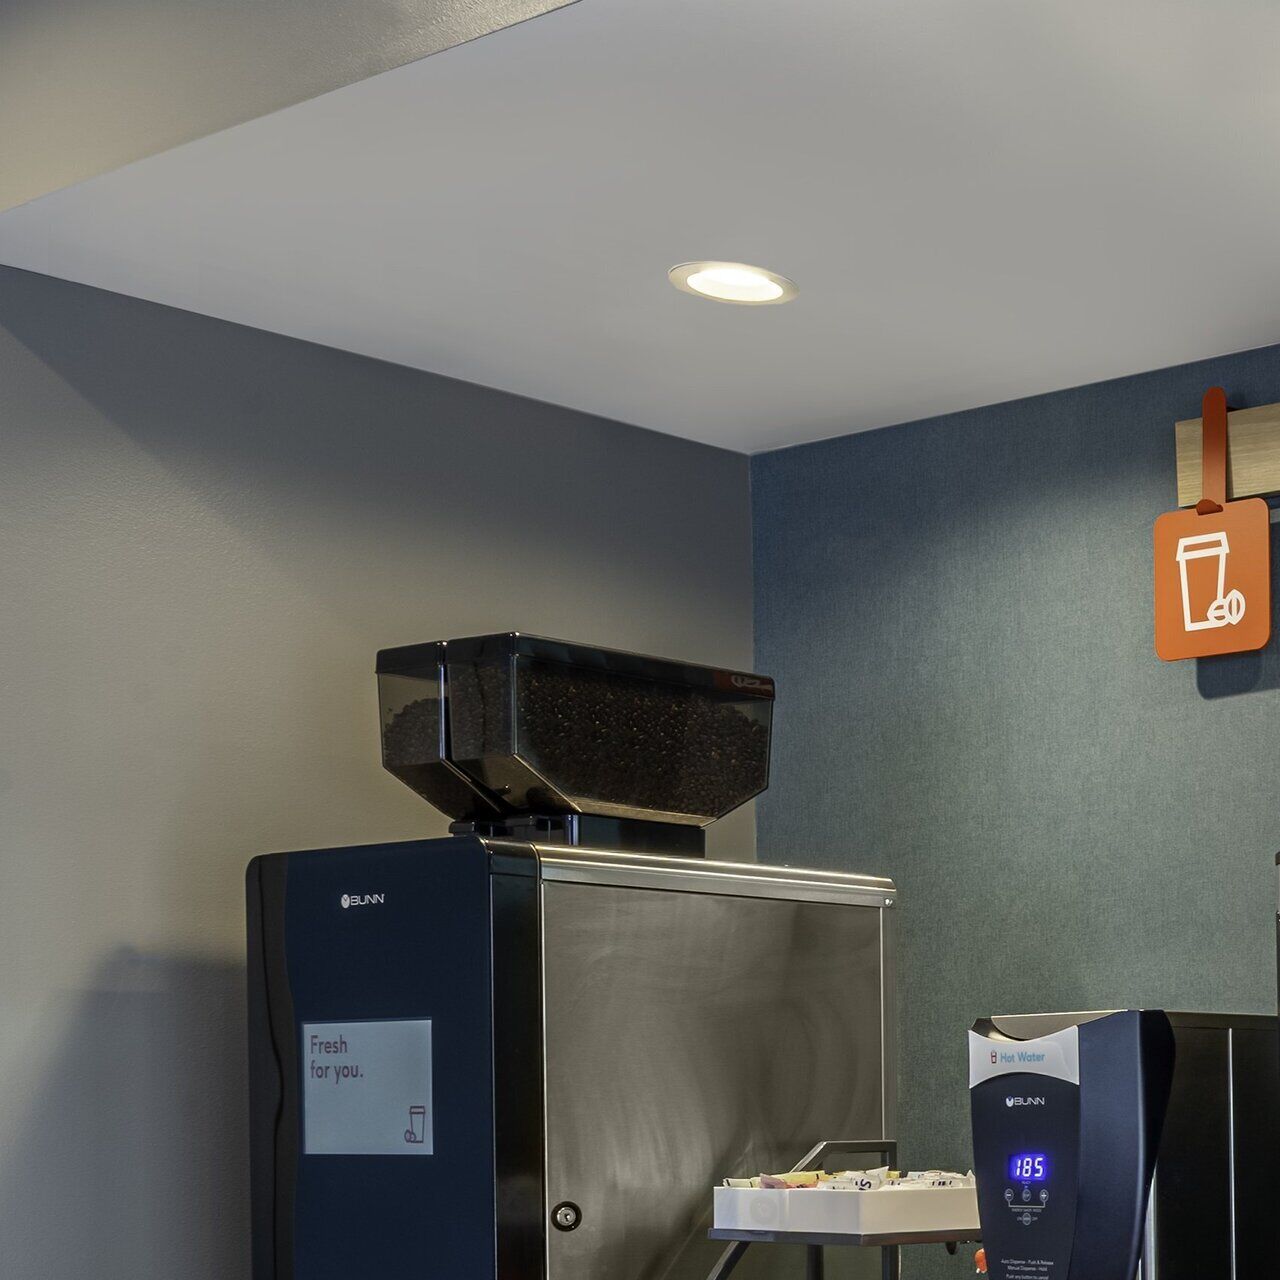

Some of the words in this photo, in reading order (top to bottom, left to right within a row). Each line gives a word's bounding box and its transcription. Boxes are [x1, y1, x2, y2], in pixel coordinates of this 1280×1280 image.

[350, 894, 384, 906] BUNN
[310, 1035, 348, 1054] Fresh
[1000, 1053, 1015, 1063] Hot
[1017, 1052, 1046, 1063] Water
[310, 1060, 330, 1078] for
[334, 1063, 364, 1084] you.
[1014, 1097, 1045, 1106] BUNN
[1016, 1157, 1044, 1177] 185
